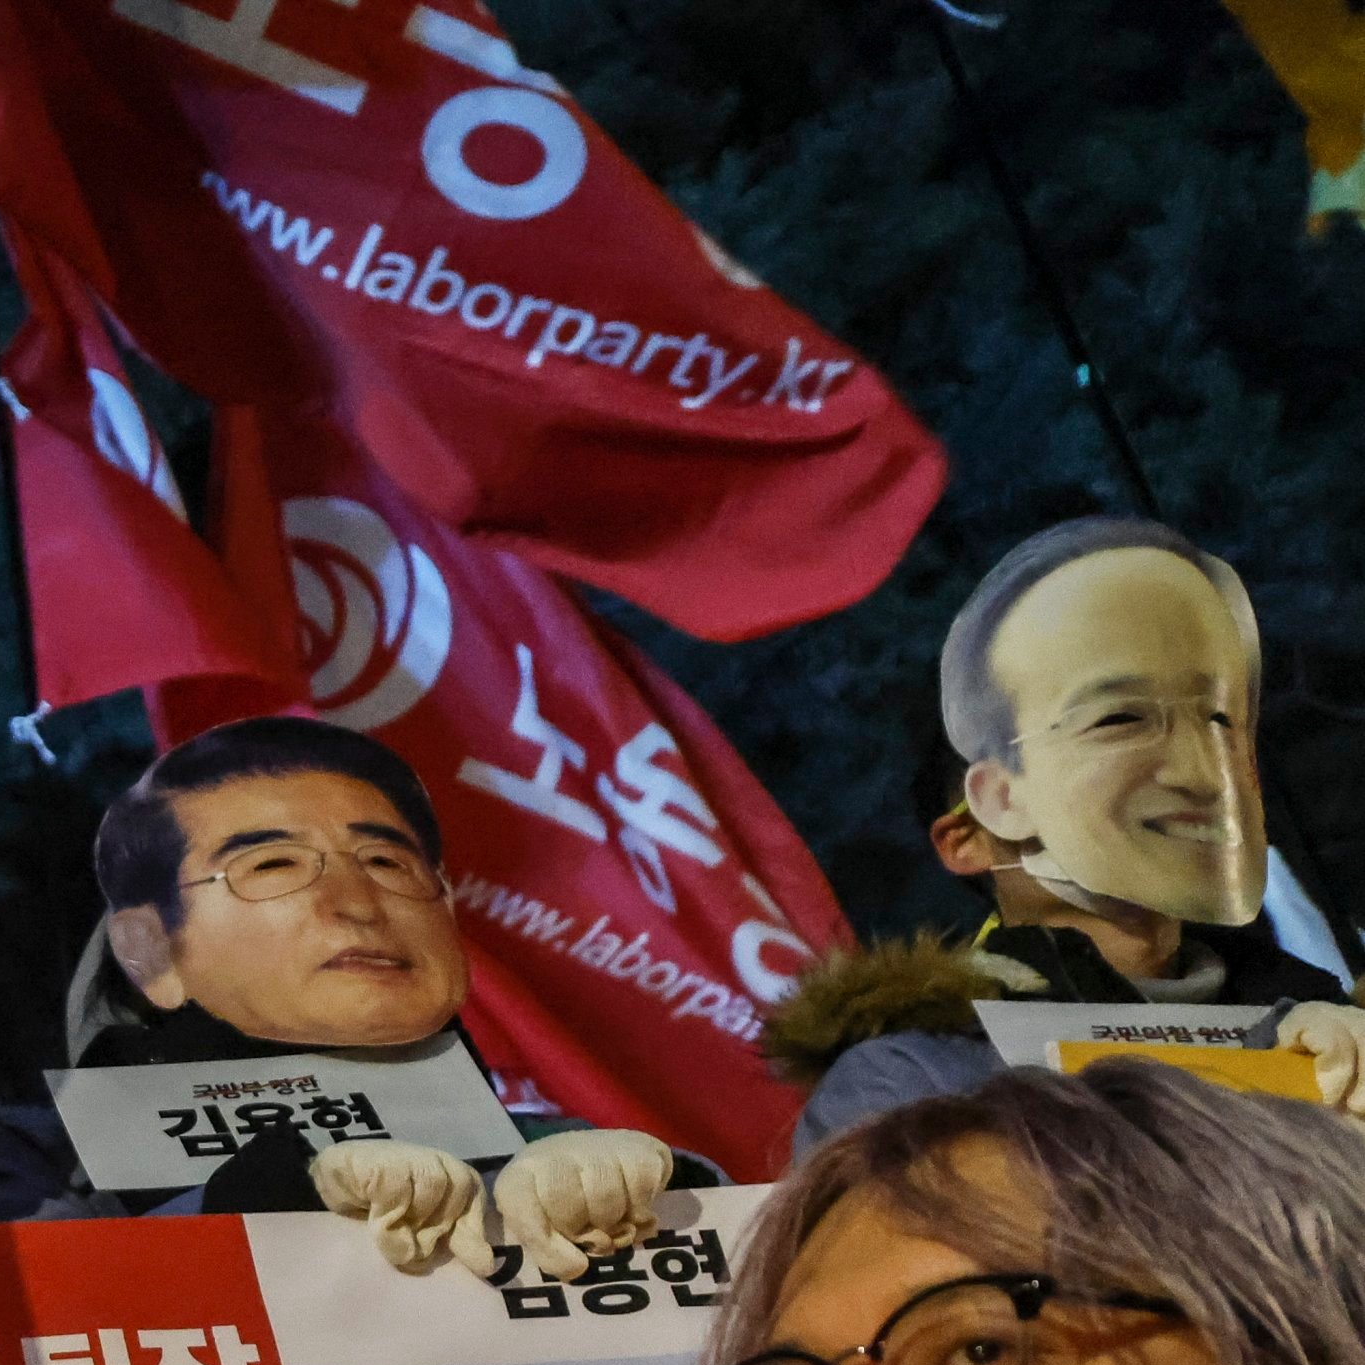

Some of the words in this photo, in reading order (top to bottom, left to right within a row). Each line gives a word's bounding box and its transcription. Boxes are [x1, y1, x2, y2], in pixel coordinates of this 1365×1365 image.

[1091, 1024, 1195, 1044] 국민의힘
[193, 1079, 266, 1101] 국방부
[269, 1074, 322, 1096] 장관
